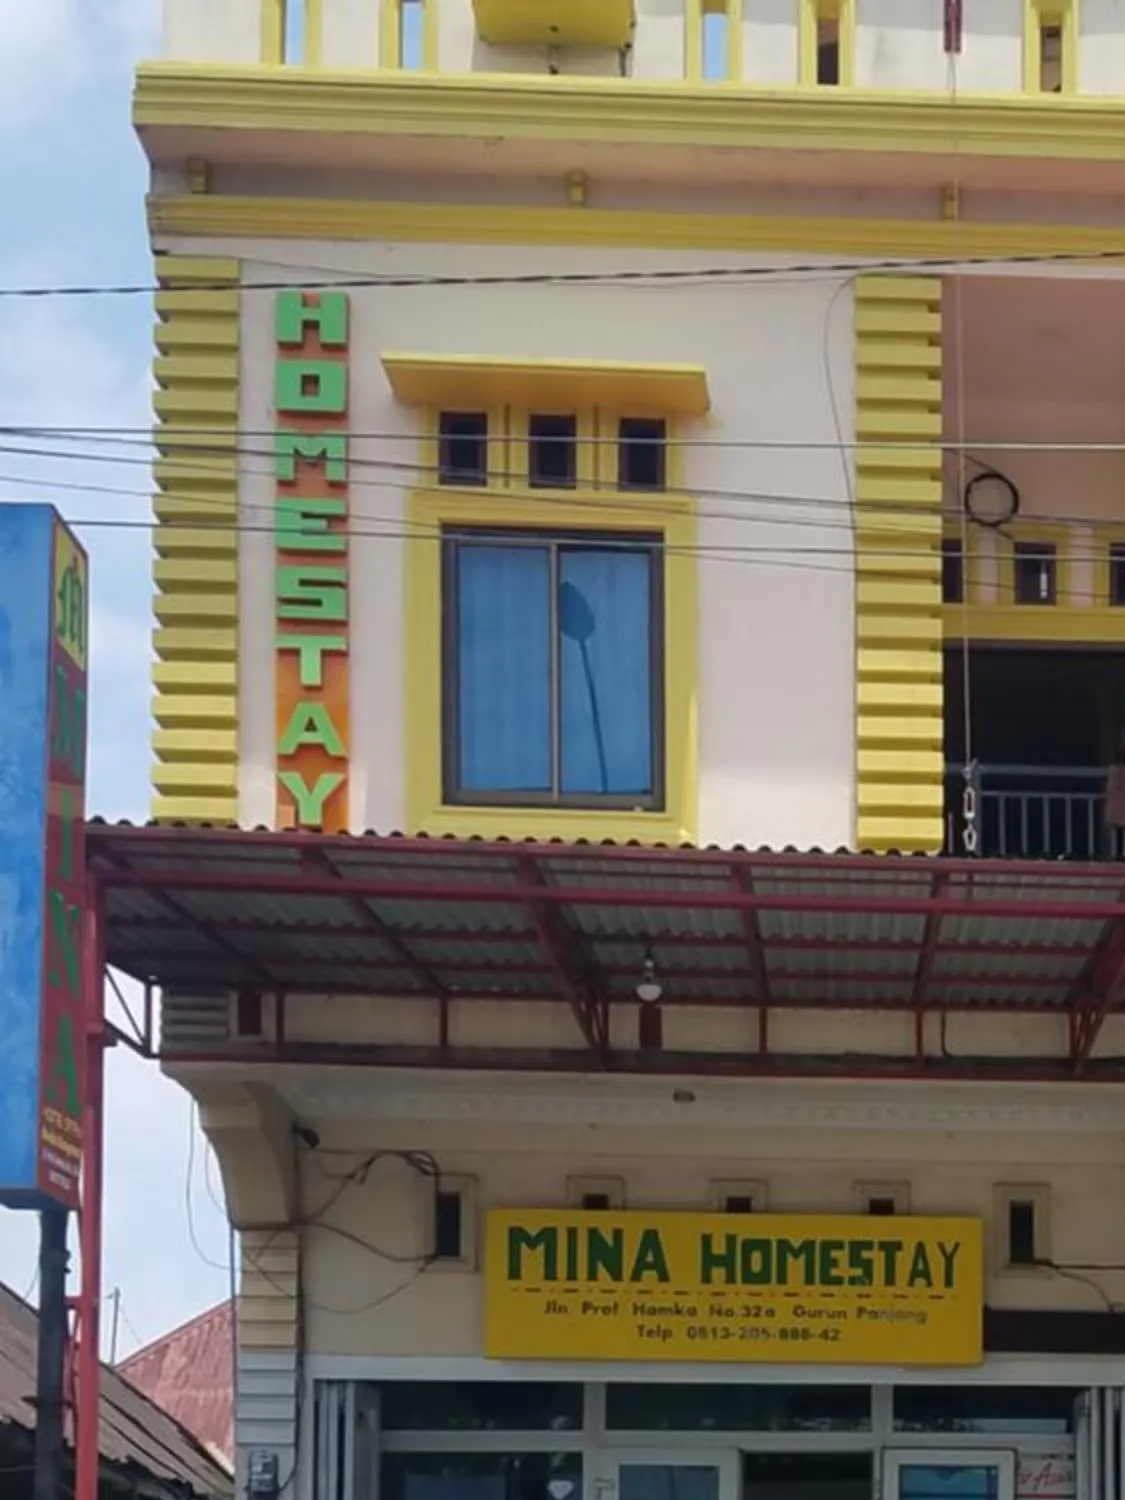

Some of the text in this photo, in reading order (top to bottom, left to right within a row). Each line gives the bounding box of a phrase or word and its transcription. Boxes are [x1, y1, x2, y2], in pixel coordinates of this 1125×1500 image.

[274, 291, 349, 826] HOMESTAY
[506, 1225, 961, 1289] MINA HOMESTAY
[581, 1300, 620, 1315] Prof
[632, 1302, 698, 1318] Hamka
[636, 1325, 673, 1343] Telp
